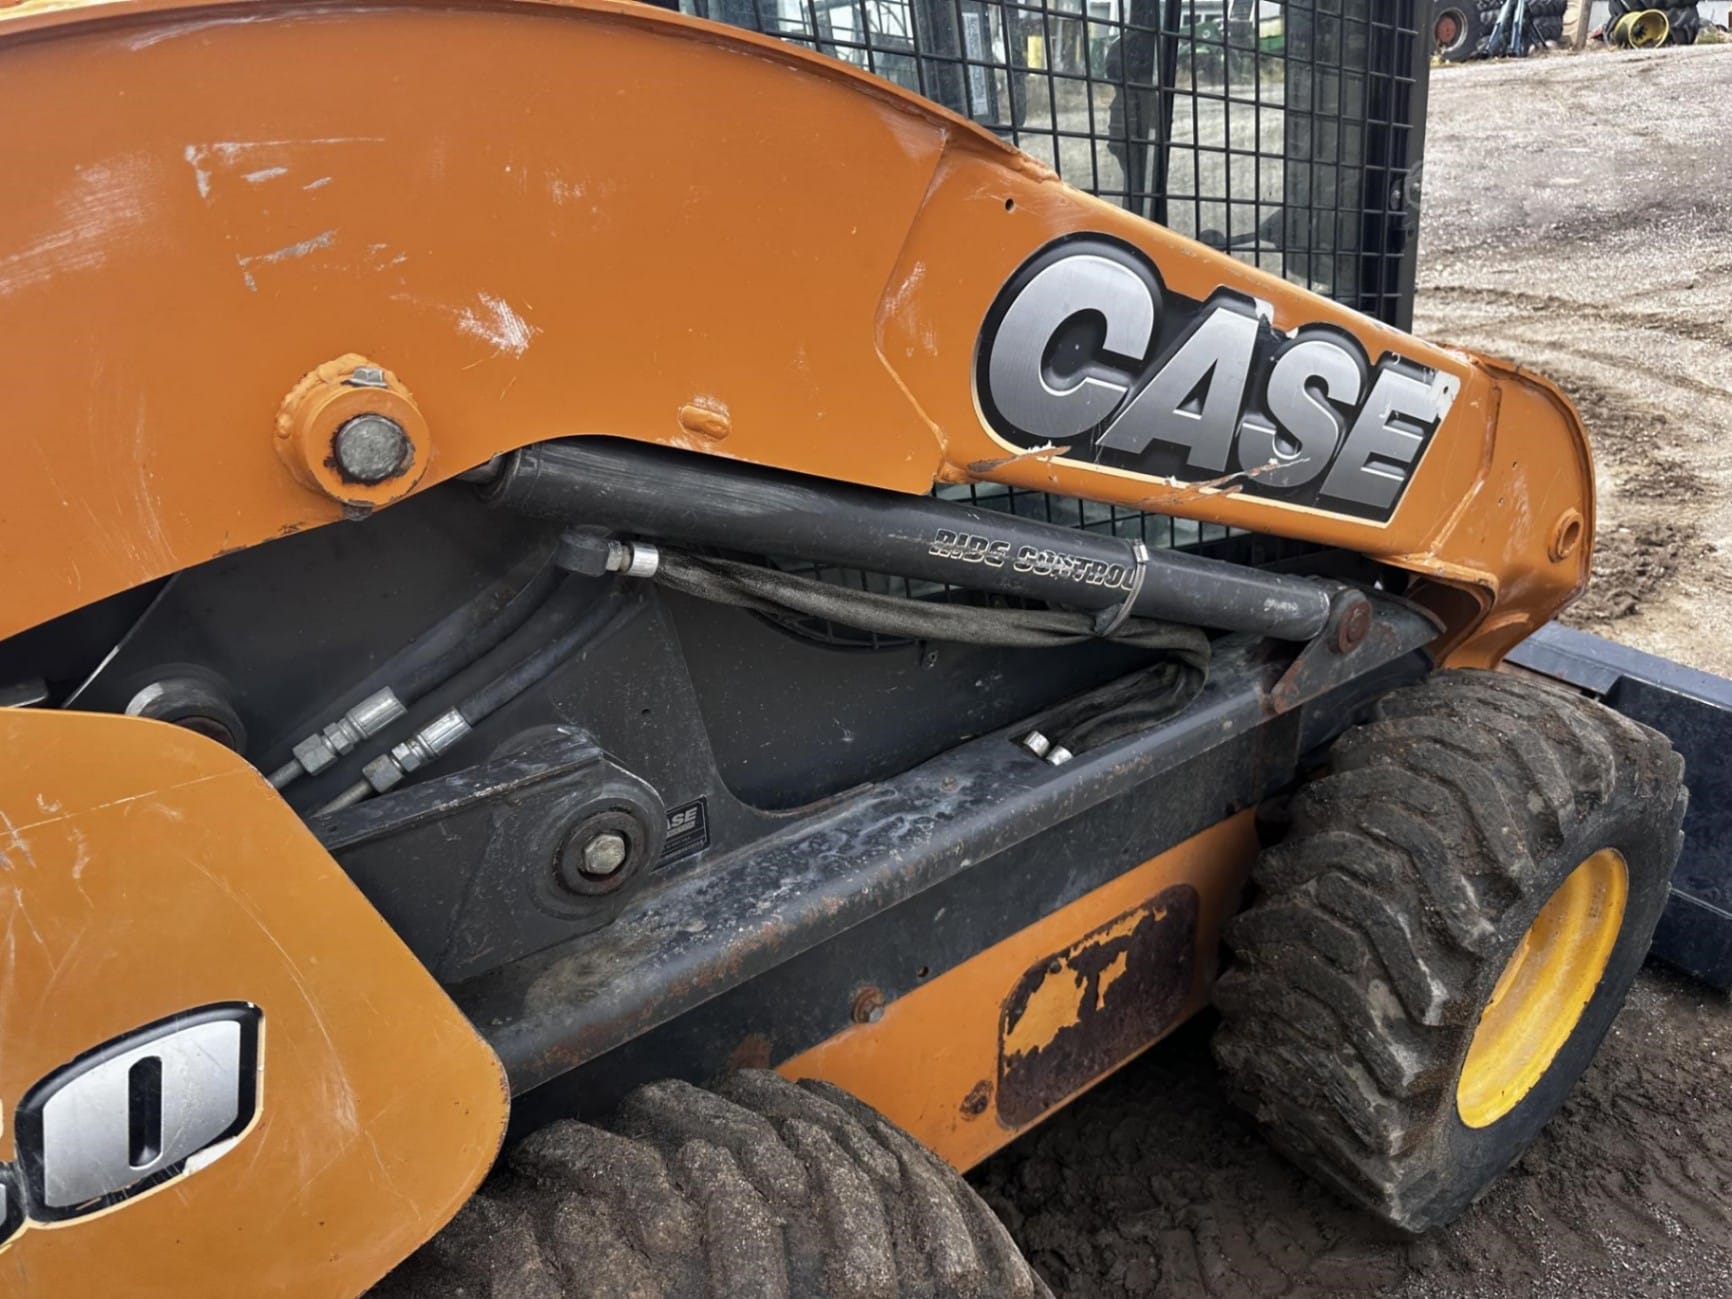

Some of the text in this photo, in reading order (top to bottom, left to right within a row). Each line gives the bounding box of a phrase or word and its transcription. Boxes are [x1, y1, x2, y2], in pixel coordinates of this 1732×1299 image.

[988, 252, 1438, 510] CASE
[928, 528, 1011, 568] RIDE
[666, 806, 698, 830] SE
[0, 1019, 241, 1226] 0
